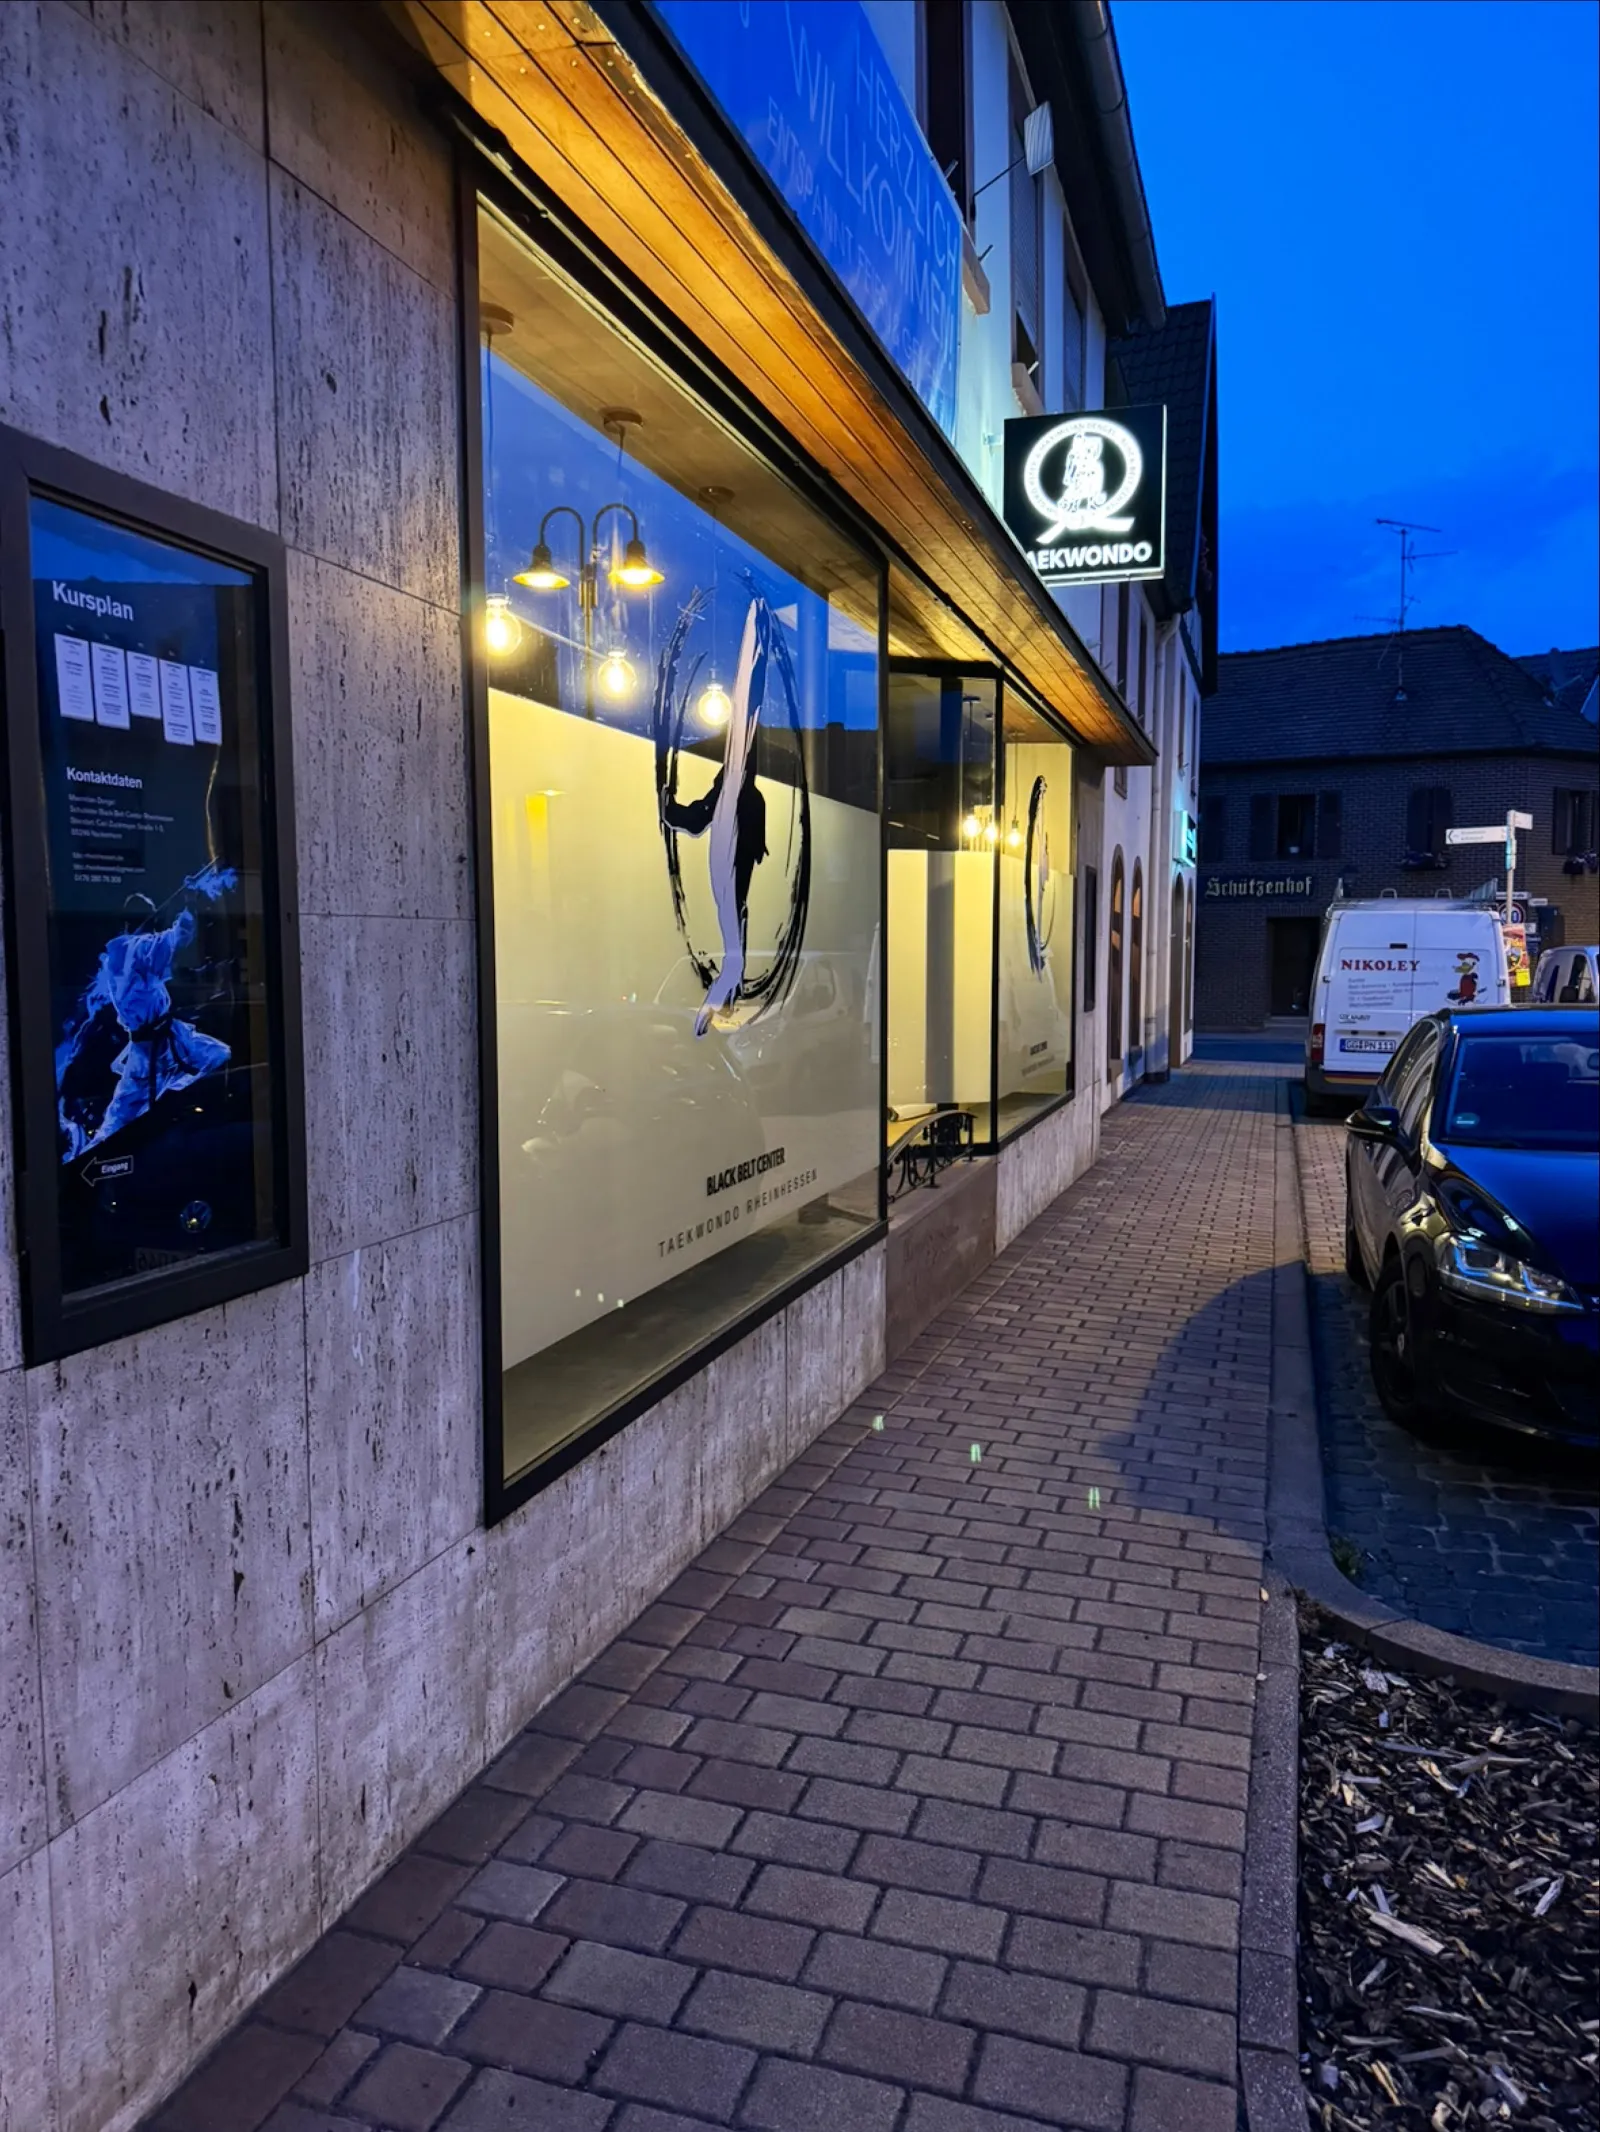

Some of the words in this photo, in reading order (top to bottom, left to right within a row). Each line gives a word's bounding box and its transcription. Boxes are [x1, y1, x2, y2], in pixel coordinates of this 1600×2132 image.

[856, 26, 959, 298] HERZLICH
[1026, 541, 1153, 570] AEKWONDO
[52, 579, 134, 622] Kursplan
[66, 766, 143, 789] Kontaktdaten
[1204, 876, 1313, 897] Schützenhof
[1340, 959, 1421, 972] NIKOLEY
[101, 1161, 129, 1175] Eingang
[706, 1165, 736, 1197] BLACK
[737, 1158, 757, 1184] BELT
[756, 1146, 786, 1176] CENTER
[657, 1205, 741, 1258] TAEKWONDO
[746, 1167, 818, 1215] RHEINHESSEN
